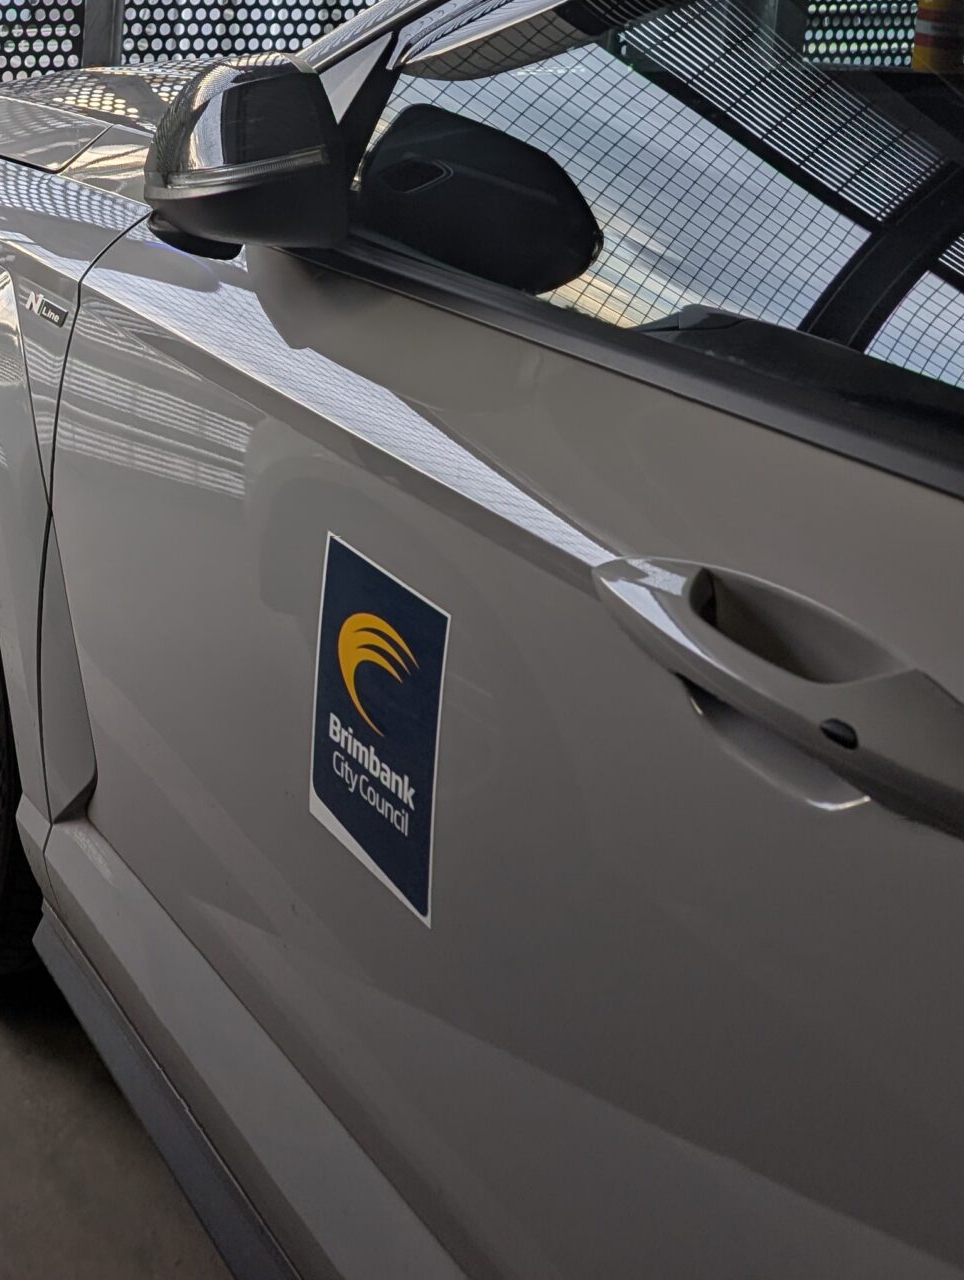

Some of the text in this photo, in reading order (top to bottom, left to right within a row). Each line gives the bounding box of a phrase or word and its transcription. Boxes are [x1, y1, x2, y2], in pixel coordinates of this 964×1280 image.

[25, 291, 60, 322] N Line
[329, 713, 416, 811] Brimbank
[333, 750, 409, 837] City Council
